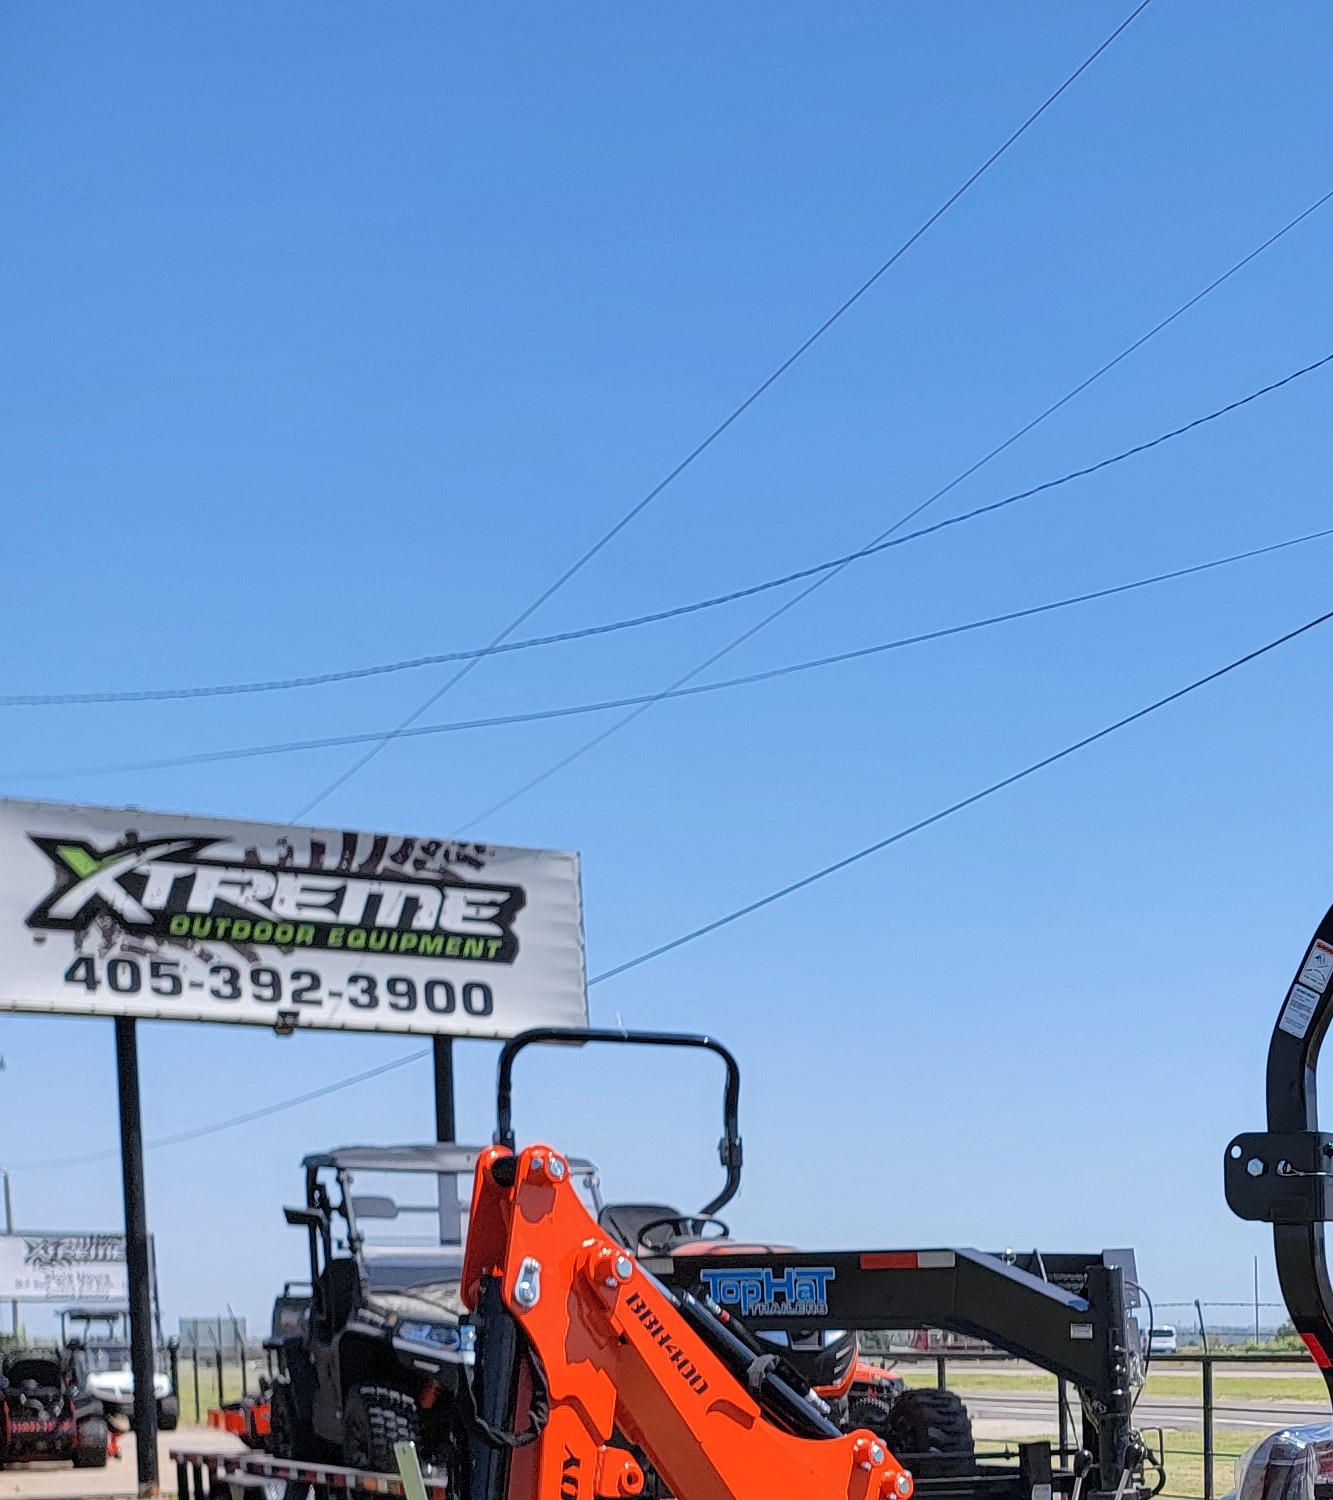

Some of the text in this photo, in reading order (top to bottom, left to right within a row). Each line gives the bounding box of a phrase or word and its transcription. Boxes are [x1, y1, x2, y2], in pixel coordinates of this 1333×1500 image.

[40, 836, 512, 936] XTREME
[169, 912, 503, 961] OUTDOOR EQUIPMENT
[64, 956, 494, 1017] 405-392-3900
